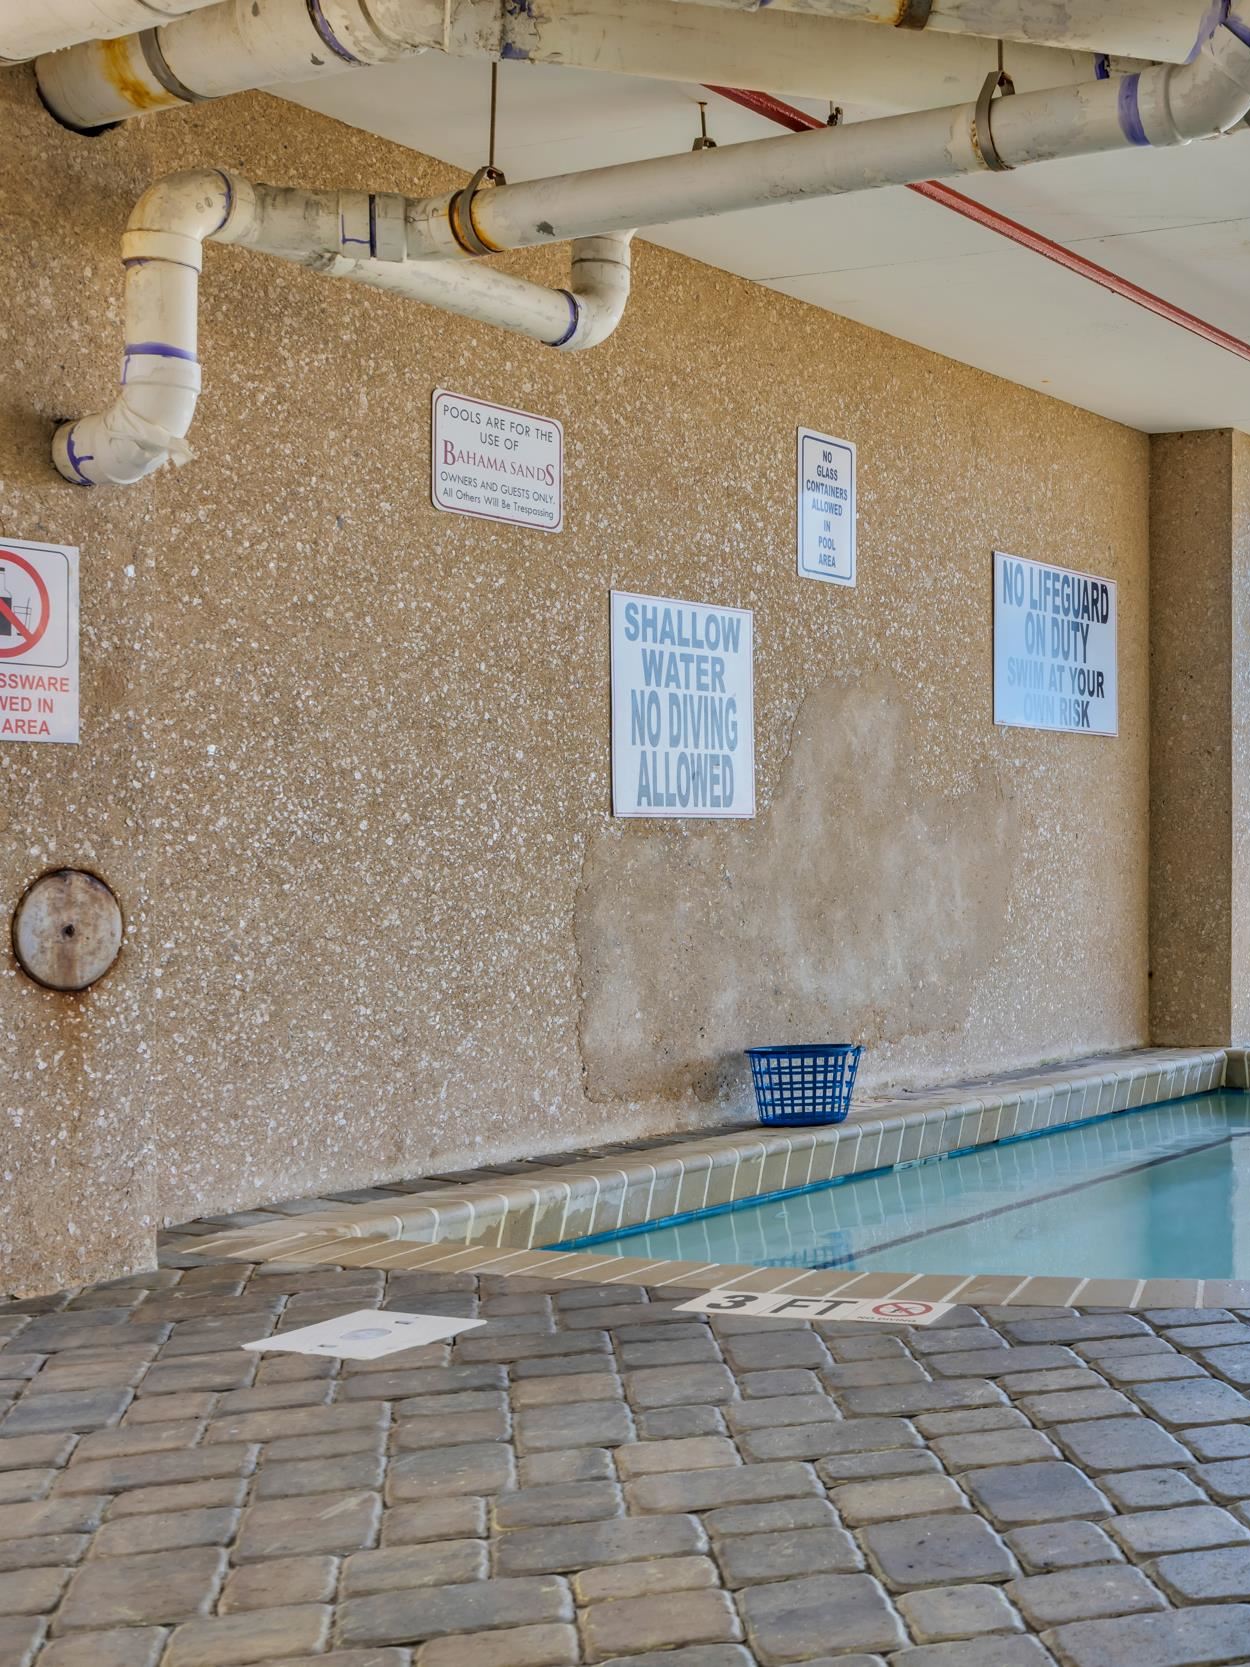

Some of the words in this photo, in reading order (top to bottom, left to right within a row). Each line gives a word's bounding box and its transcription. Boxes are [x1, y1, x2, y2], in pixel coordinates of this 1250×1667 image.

[443, 404, 481, 425] POOLS
[486, 416, 506, 431] ARE
[510, 421, 531, 436] FOR
[535, 428, 553, 443] THE
[480, 432, 500, 447] USE
[504, 438, 519, 451] OF
[822, 449, 833, 464] NO
[443, 439, 507, 473] BAHAMA
[510, 461, 555, 486] SANDS
[816, 464, 838, 481] GLASS
[440, 471, 478, 488] OWNERS
[480, 481, 498, 492] AND
[500, 484, 530, 500] GUESTS
[532, 491, 555, 505] ONLY.
[442, 487, 453, 498] All
[456, 489, 481, 504] Others
[483, 495, 499, 507] Will
[501, 499, 511, 510] Be
[513, 502, 554, 520] Trespassing
[806, 479, 848, 501] CONTAINERS
[811, 498, 843, 517] ALLOWED
[823, 519, 831, 533] IN
[818, 535, 836, 551] POOL
[818, 553, 836, 568] AREA
[1003, 559, 1025, 608] NO
[1029, 566, 1109, 625] LIFEGUARD
[624, 601, 741, 654] SHALLOW
[1024, 611, 1046, 657] ON
[1051, 616, 1090, 664] DUTY
[641, 648, 726, 694] WATER
[1007, 656, 1044, 689] SWIM
[1048, 662, 1065, 693] AT
[1069, 666, 1105, 699] YOUR
[38, 698, 54, 713] IN
[630, 688, 662, 748] NO
[668, 692, 738, 752] DIVING
[1023, 692, 1055, 724] OWN
[1059, 696, 1090, 728] RISK
[1, 718, 51, 735] AREA
[636, 750, 734, 808] ALLOWED
[706, 1294, 759, 1310] 3
[769, 1298, 858, 1316] FT
